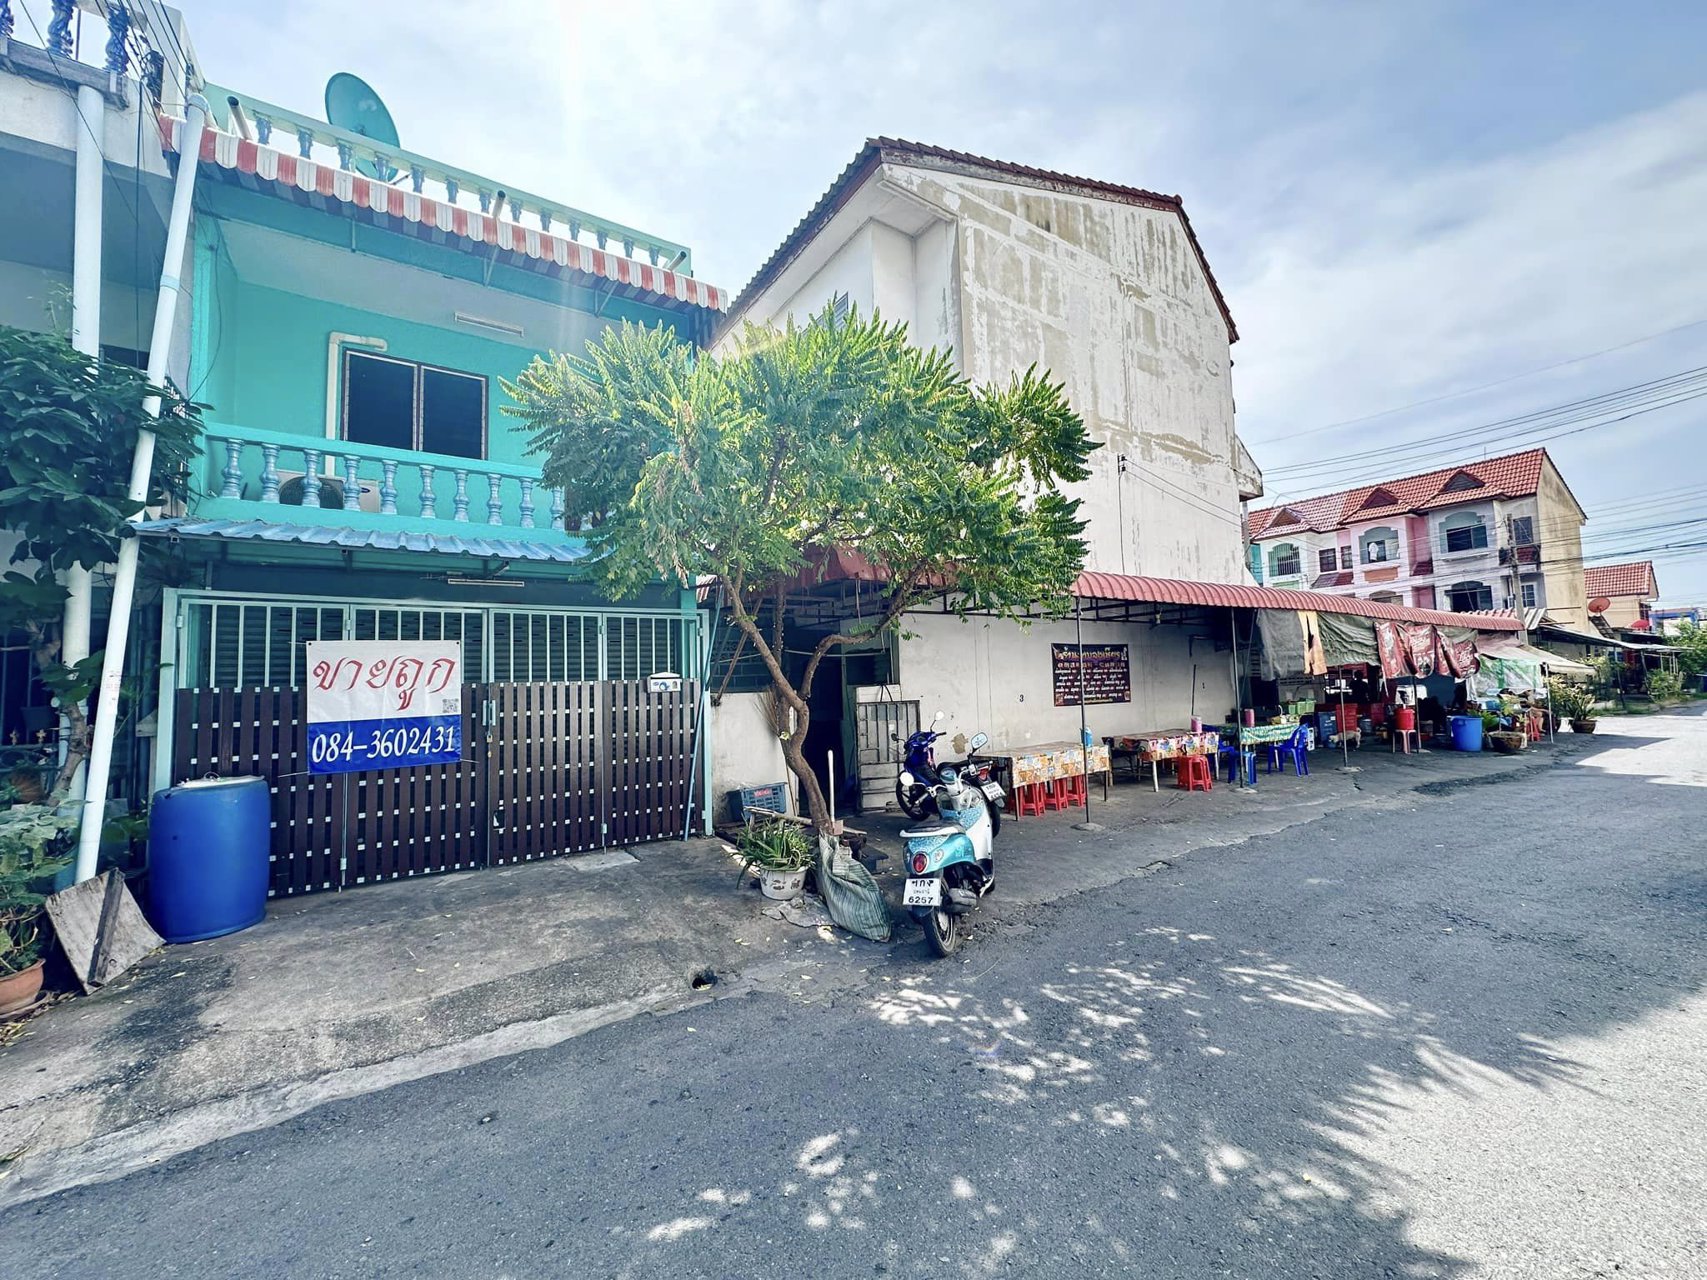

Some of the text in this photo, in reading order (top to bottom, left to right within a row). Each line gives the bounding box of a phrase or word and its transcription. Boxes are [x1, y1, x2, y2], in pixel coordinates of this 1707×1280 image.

[312, 655, 456, 711] ขายถูก
[311, 726, 455, 763] 084-3602431
[908, 895, 934, 904] 6257
